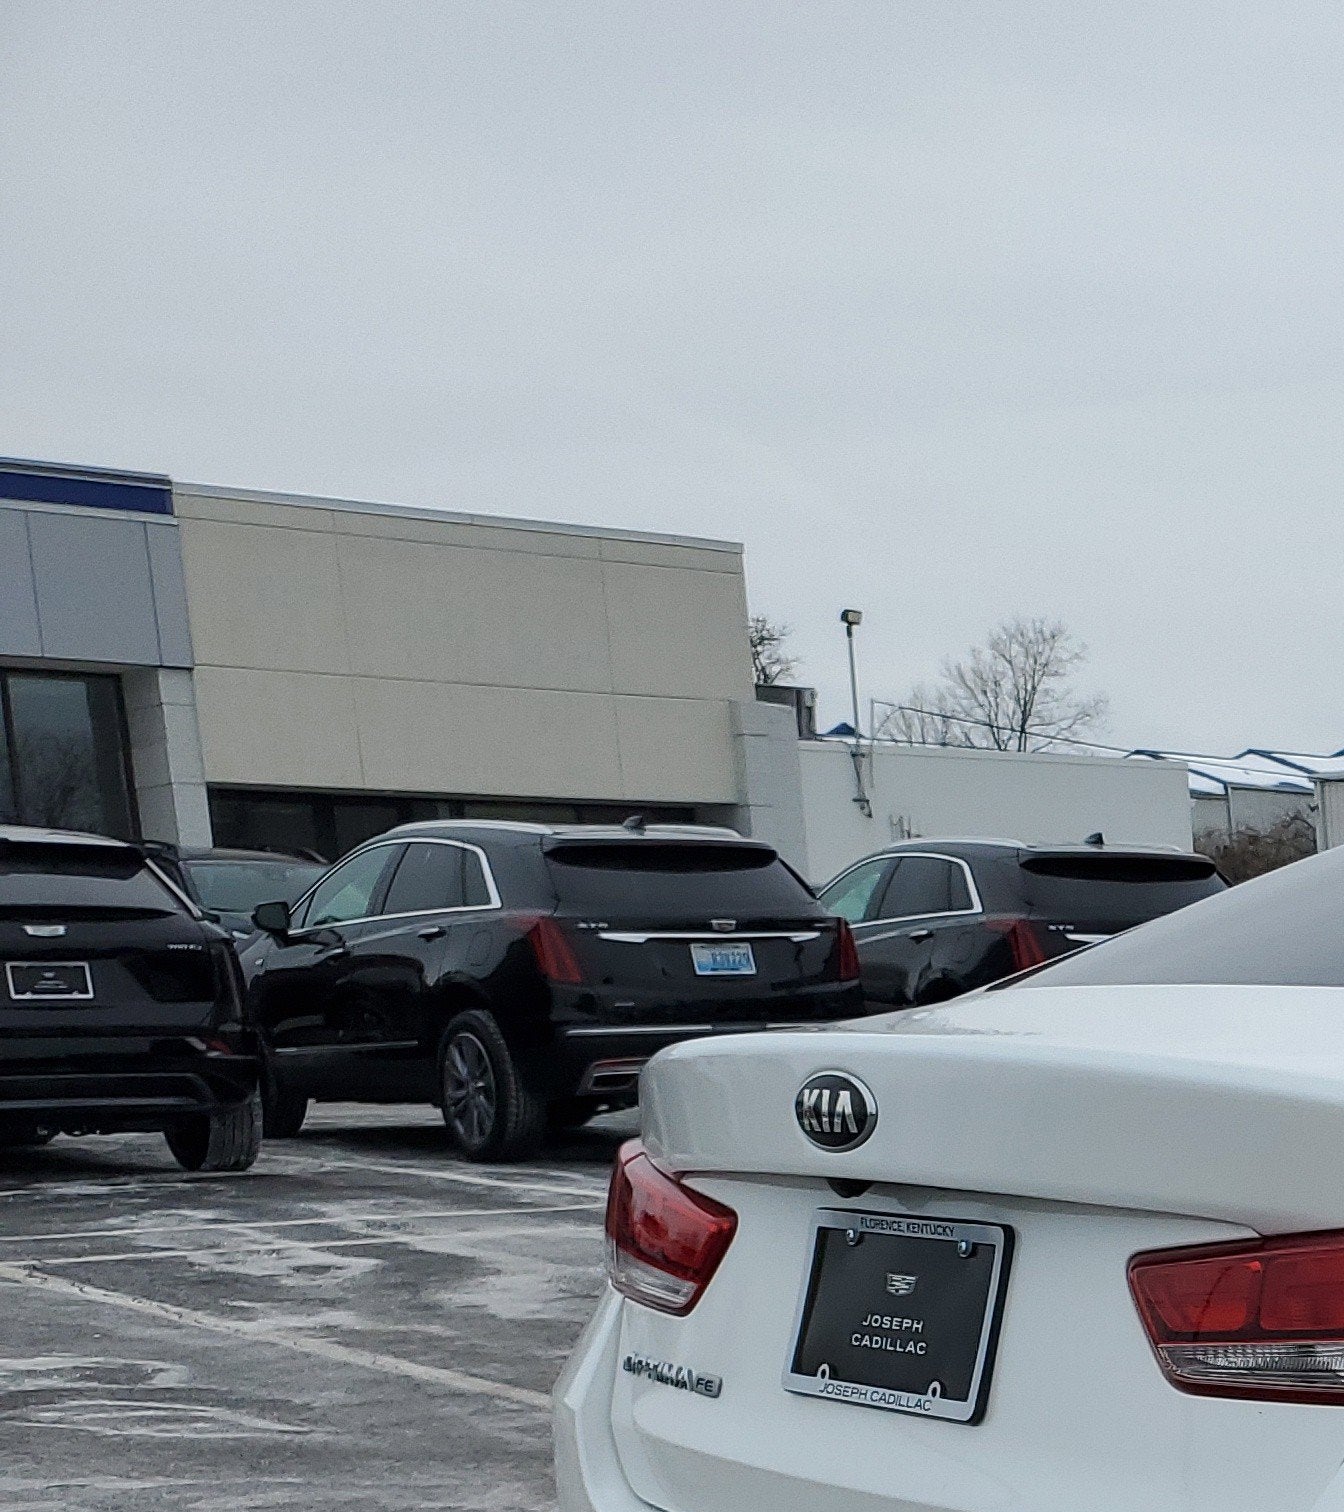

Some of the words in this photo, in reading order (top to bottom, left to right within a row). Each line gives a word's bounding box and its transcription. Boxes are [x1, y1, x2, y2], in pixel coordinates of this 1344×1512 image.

[802, 1088, 858, 1133] KIA
[906, 1222, 955, 1237] KENTUCKY
[862, 1314, 924, 1333] JOSEPH
[851, 1333, 927, 1355] CADILLAC
[819, 1382, 868, 1401] JOSEPH
[869, 1390, 932, 1412] CADILLAC
